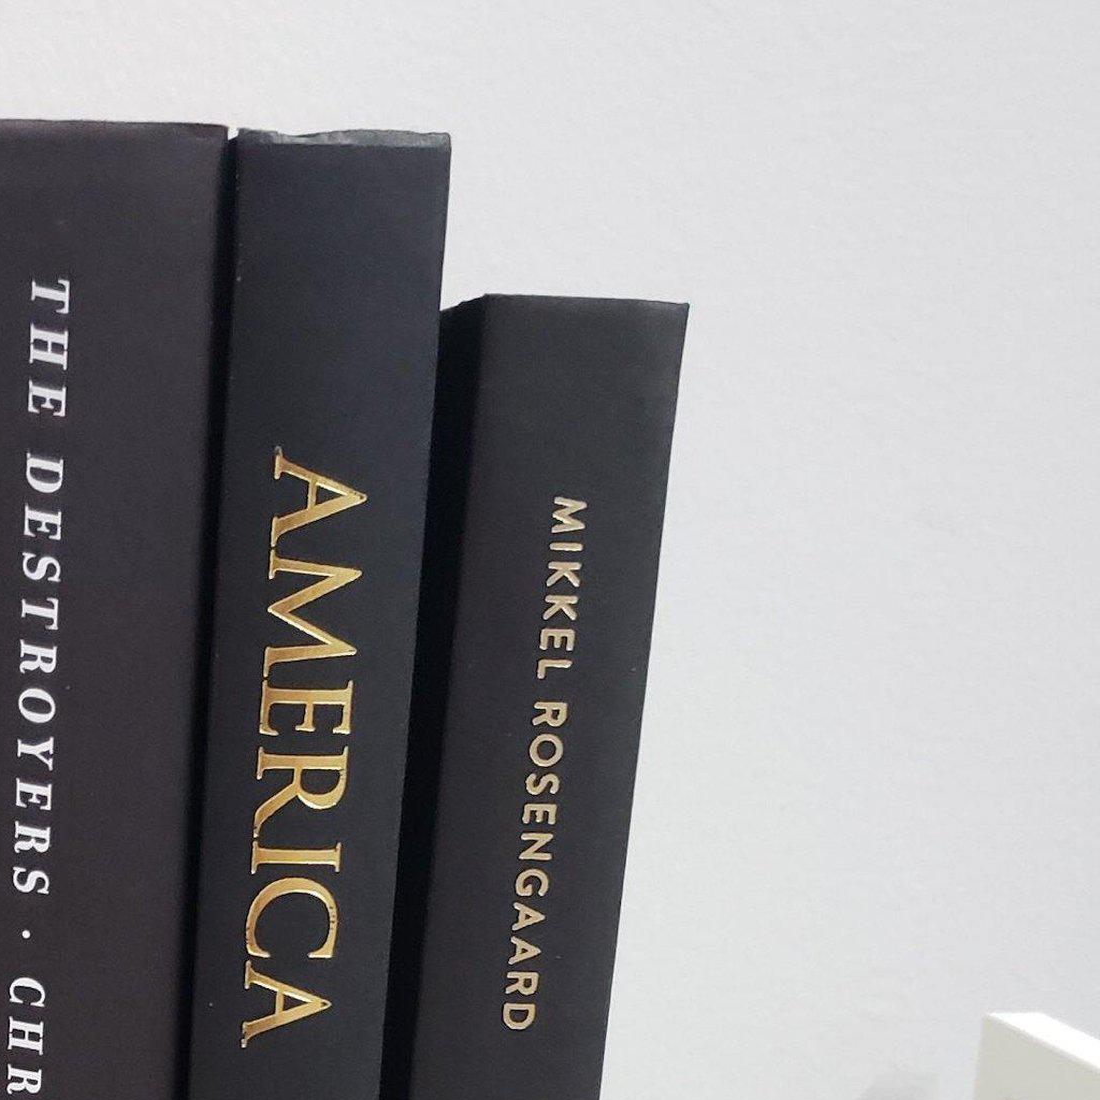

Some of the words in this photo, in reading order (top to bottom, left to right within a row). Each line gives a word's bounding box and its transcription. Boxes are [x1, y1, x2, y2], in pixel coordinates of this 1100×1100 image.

[28, 279, 70, 417] THE
[13, 452, 63, 894] DESTROYERS
[241, 446, 367, 1048] AMERICA
[537, 497, 587, 679] MIKKEL
[503, 702, 568, 1029] ROSENGAARD
